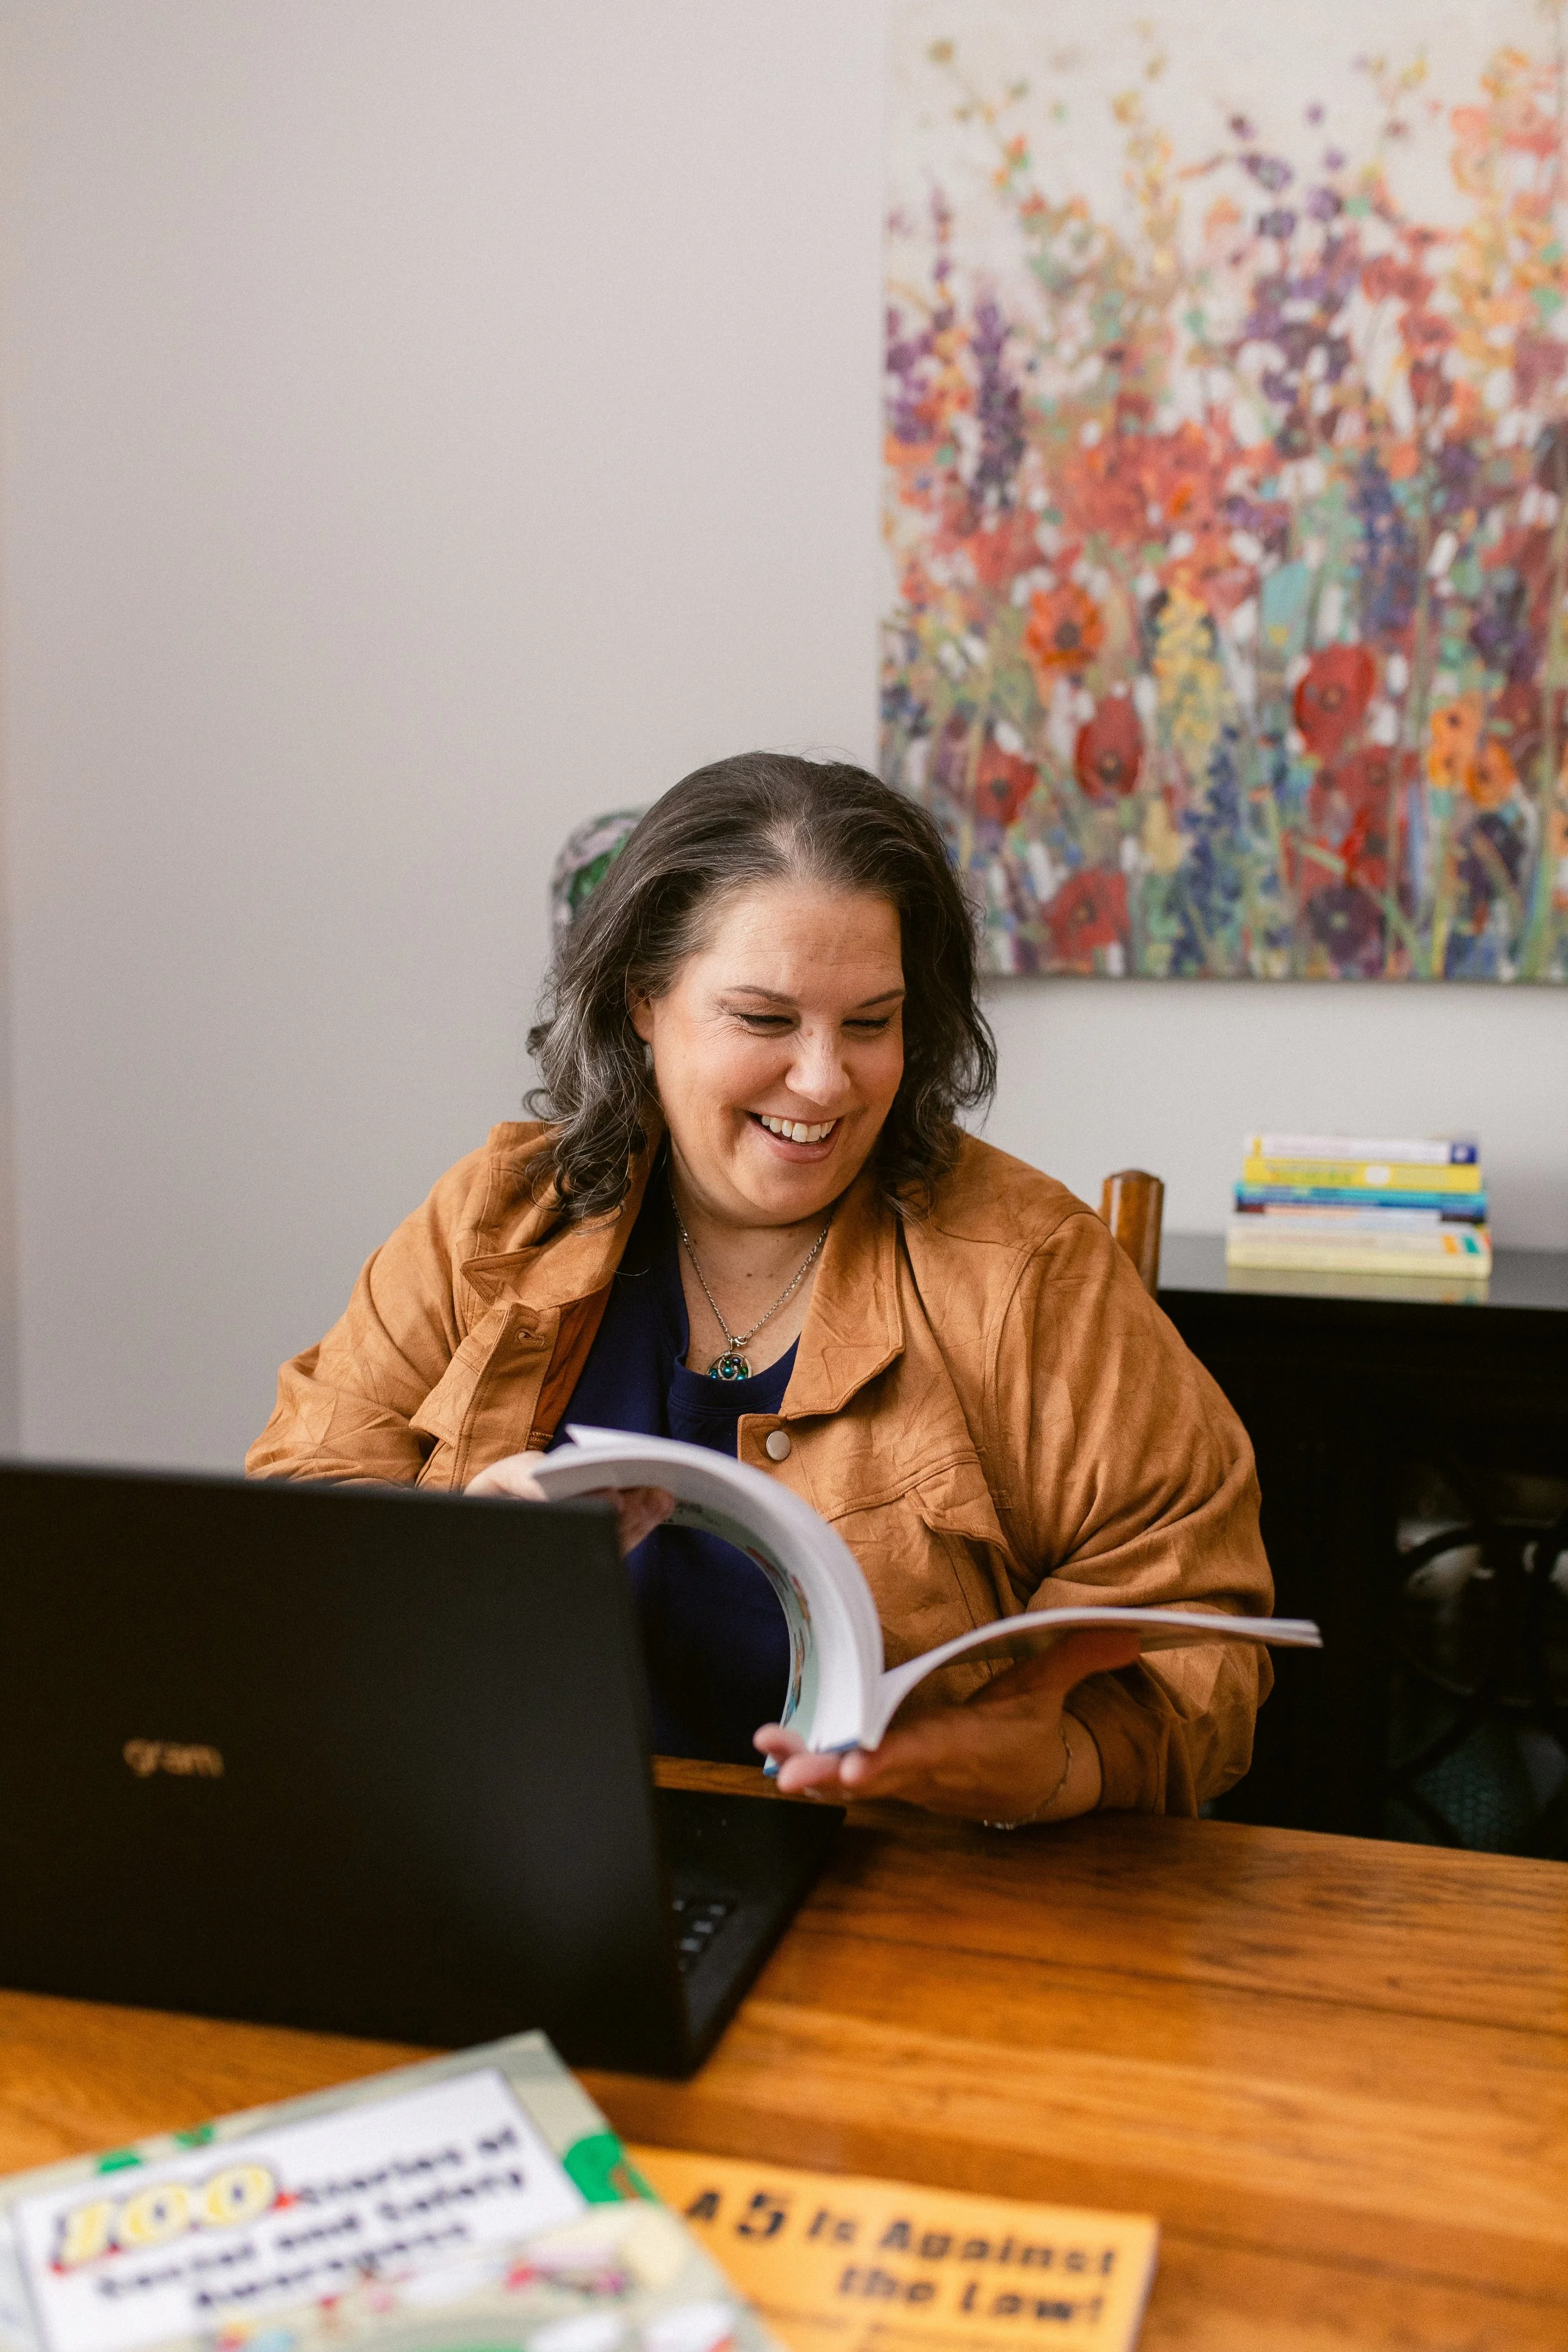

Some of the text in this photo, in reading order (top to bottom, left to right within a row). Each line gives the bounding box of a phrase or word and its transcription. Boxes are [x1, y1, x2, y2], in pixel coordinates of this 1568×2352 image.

[50, 2158, 283, 2275] 100
[685, 2189, 722, 2223] A
[736, 2189, 790, 2240] 5
[879, 2218, 1116, 2277] Against
[837, 2264, 936, 2304] the
